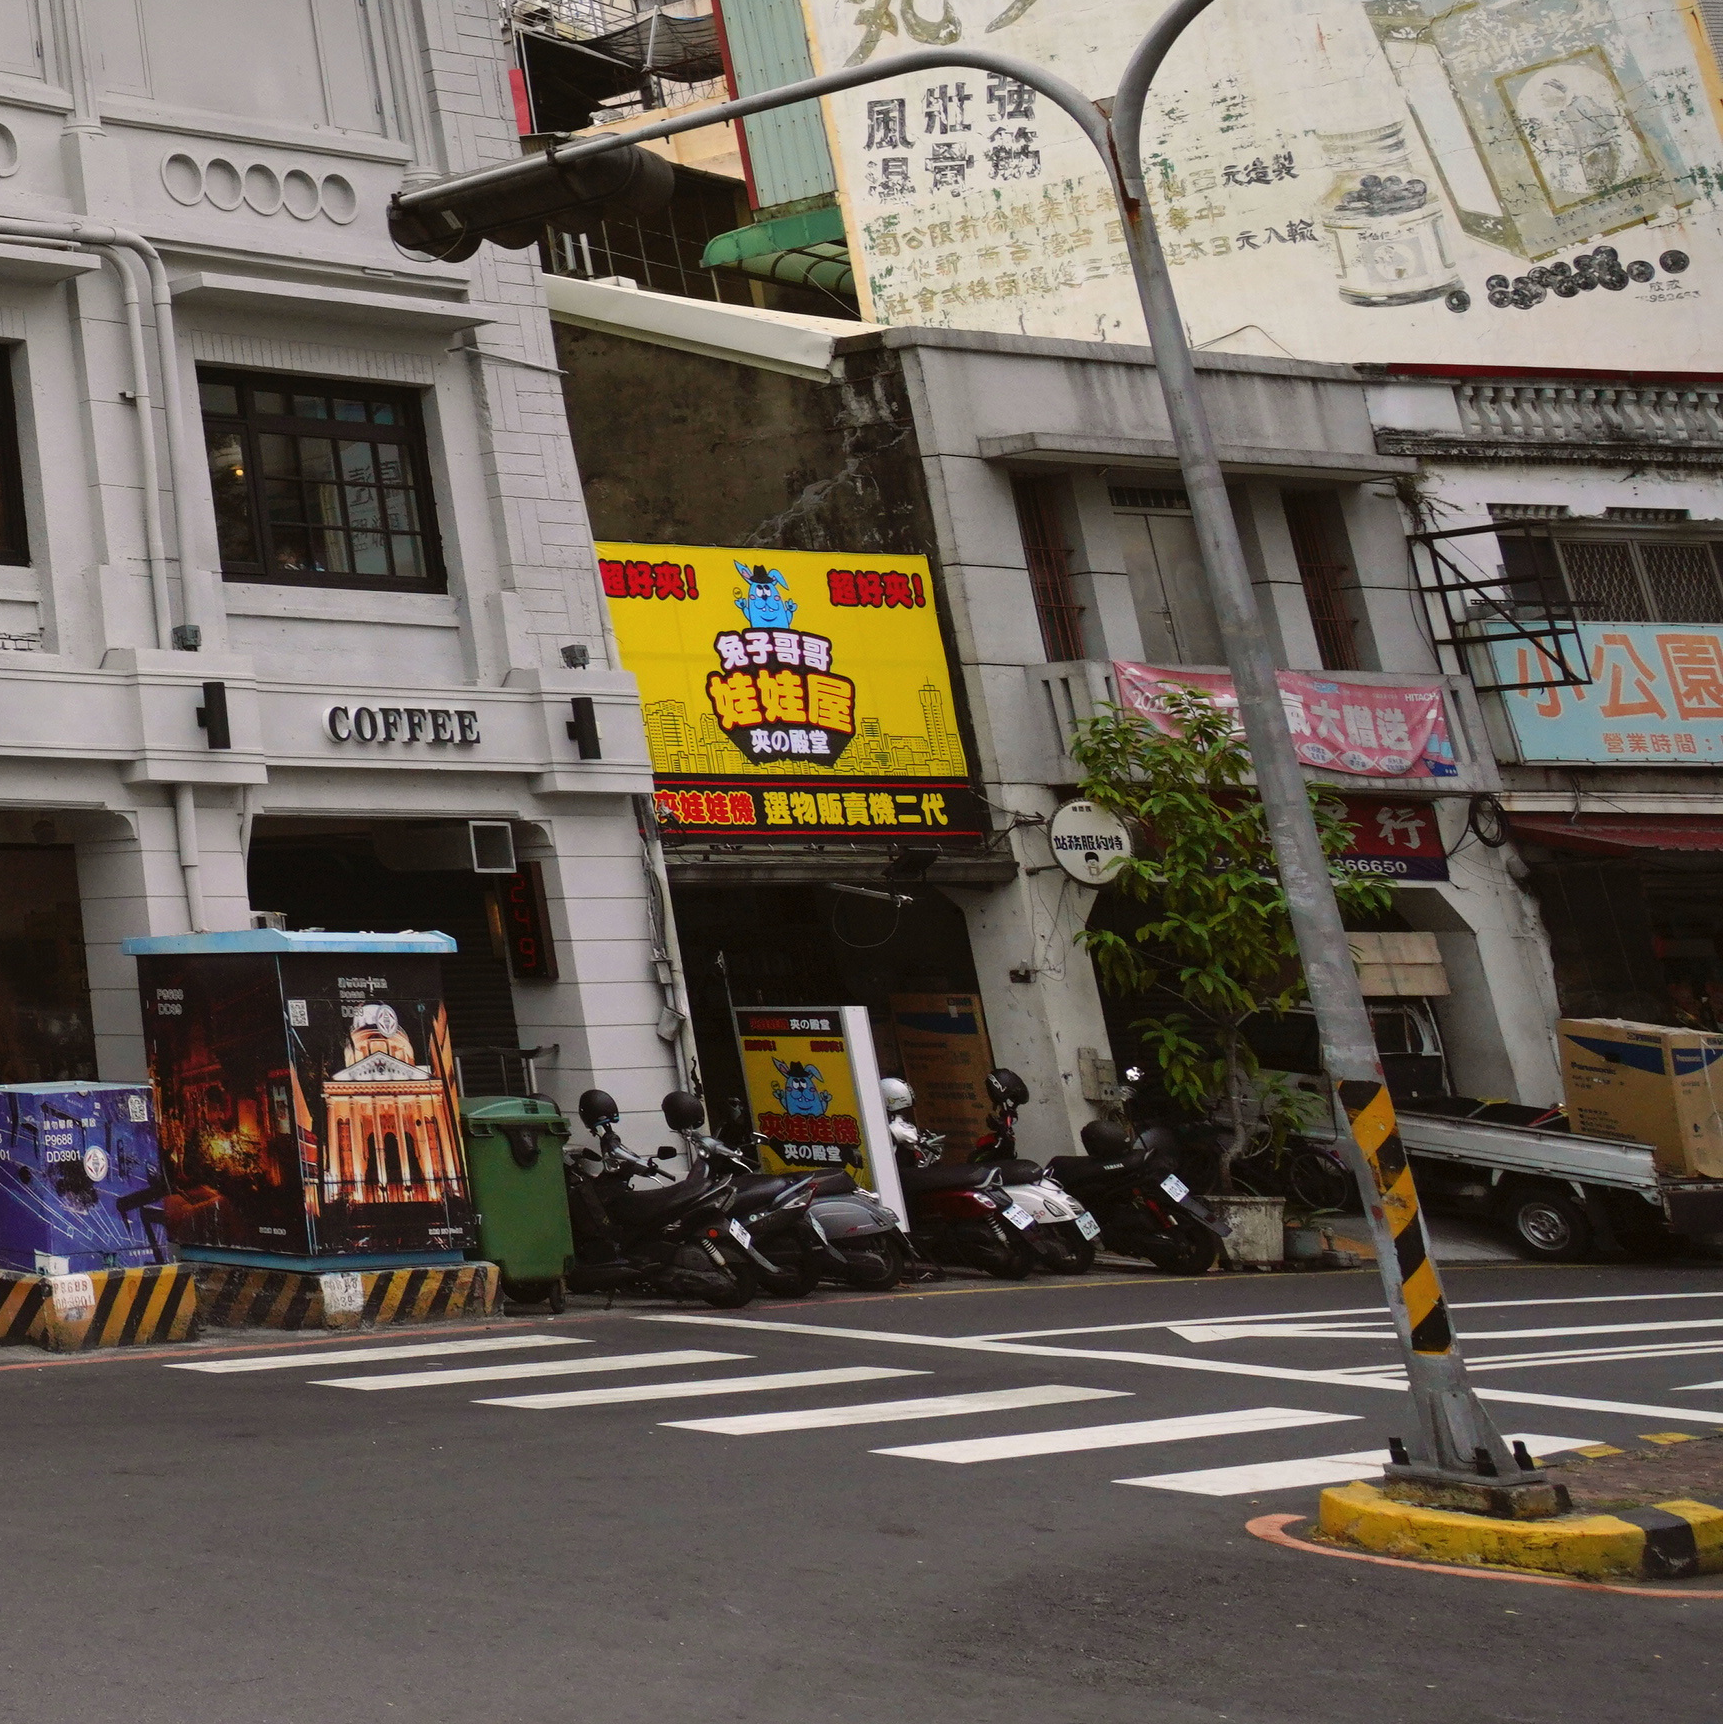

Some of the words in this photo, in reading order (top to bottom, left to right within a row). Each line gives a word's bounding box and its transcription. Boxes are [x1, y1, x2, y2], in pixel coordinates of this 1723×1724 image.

[716, 632, 830, 672] 兔子哥哥
[710, 672, 855, 735] 娃娃屋
[327, 705, 481, 745] COFFEE
[750, 728, 831, 756] 夾の殿堂
[764, 791, 949, 827] 選物販賣機二代
[45, 1133, 73, 1146] P9688
[759, 1112, 860, 1145] 夾娃娃機
[46, 1150, 81, 1163] DD3901
[784, 1143, 843, 1162] 夾の殿堂
